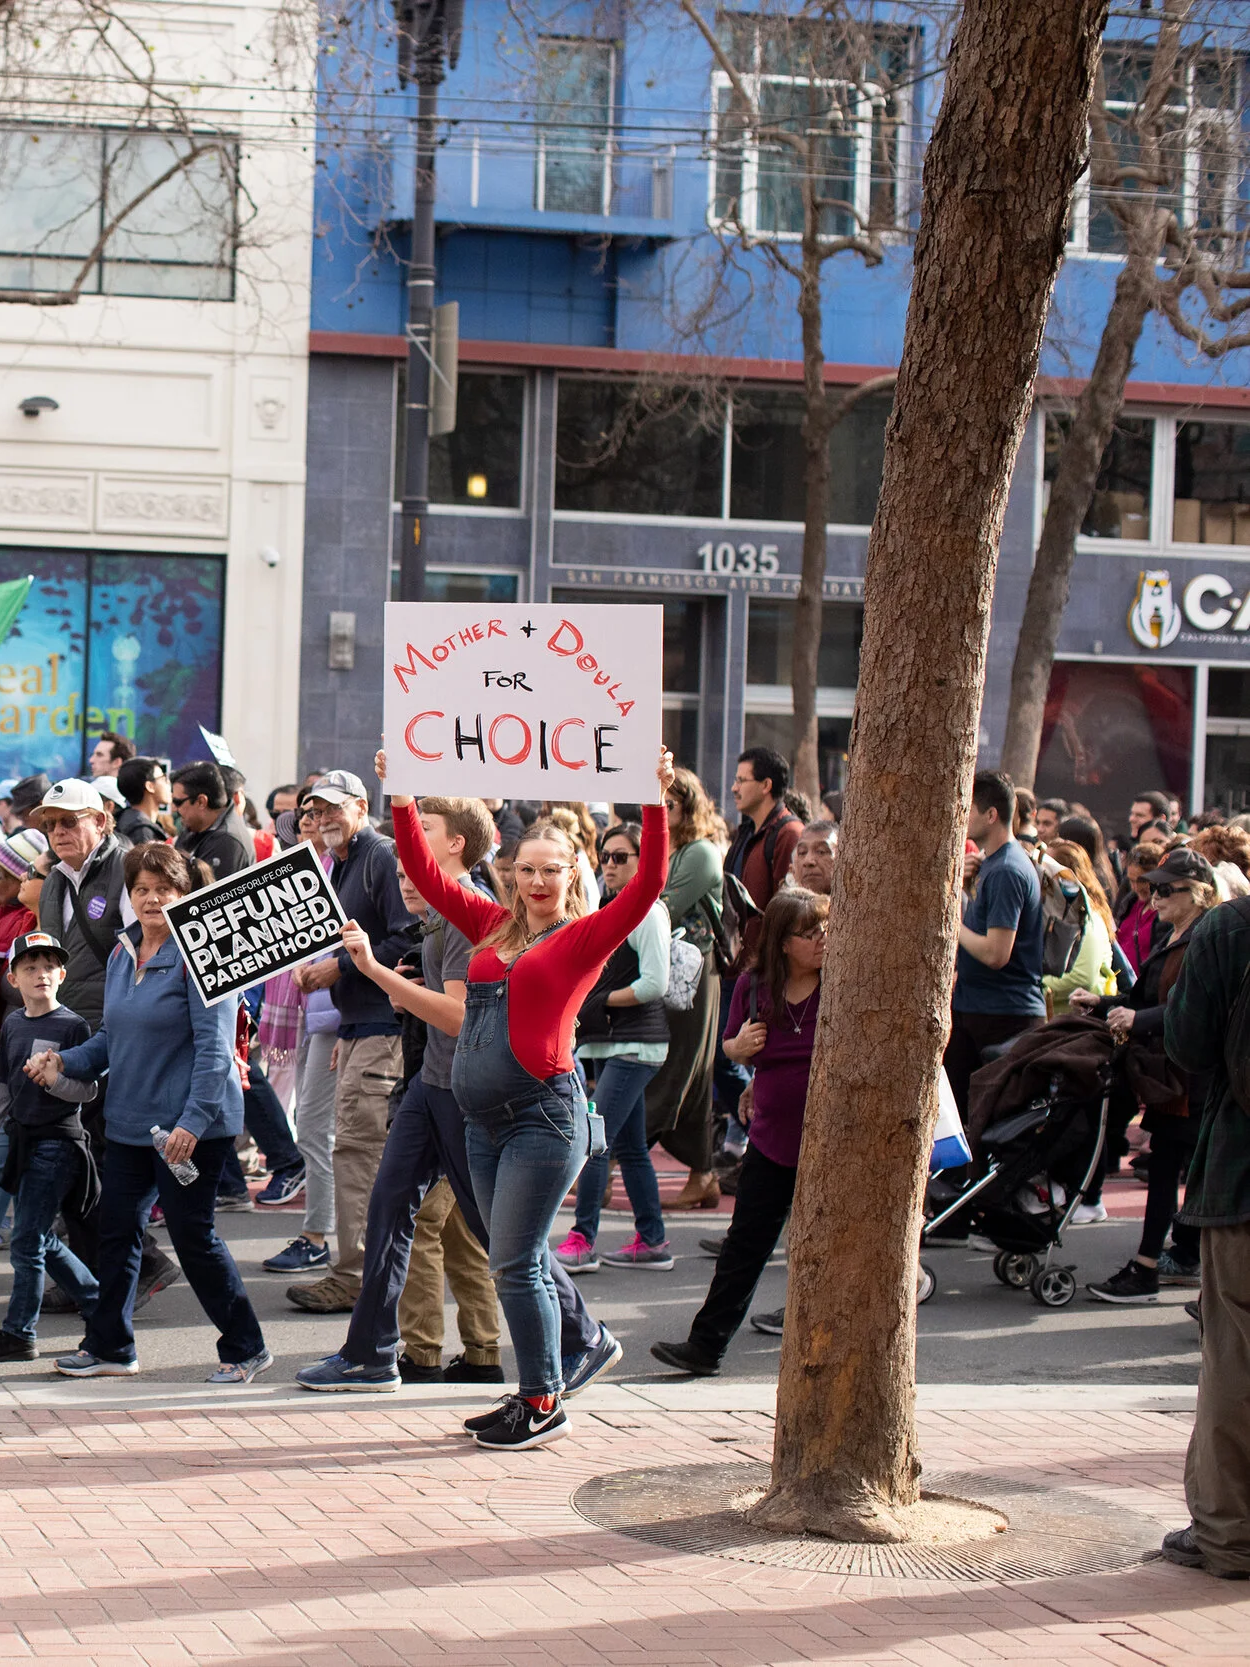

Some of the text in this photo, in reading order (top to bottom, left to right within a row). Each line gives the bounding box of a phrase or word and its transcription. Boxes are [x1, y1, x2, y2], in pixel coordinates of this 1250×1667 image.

[566, 569, 601, 584] SAN
[613, 571, 719, 590] FRANCISCO
[729, 577, 771, 593] AIDS
[698, 541, 779, 577] 1035
[393, 619, 508, 693] MOTHER
[1179, 632, 1239, 643] CALIFORNIA
[482, 670, 533, 692] FOR
[404, 710, 623, 773] CHOICE
[179, 869, 320, 951] DEFUND
[200, 863, 294, 911] STUDENTSFORLIFE.ORG
[191, 896, 331, 974] PLANNED
[201, 918, 340, 992] PARENTHOOD
